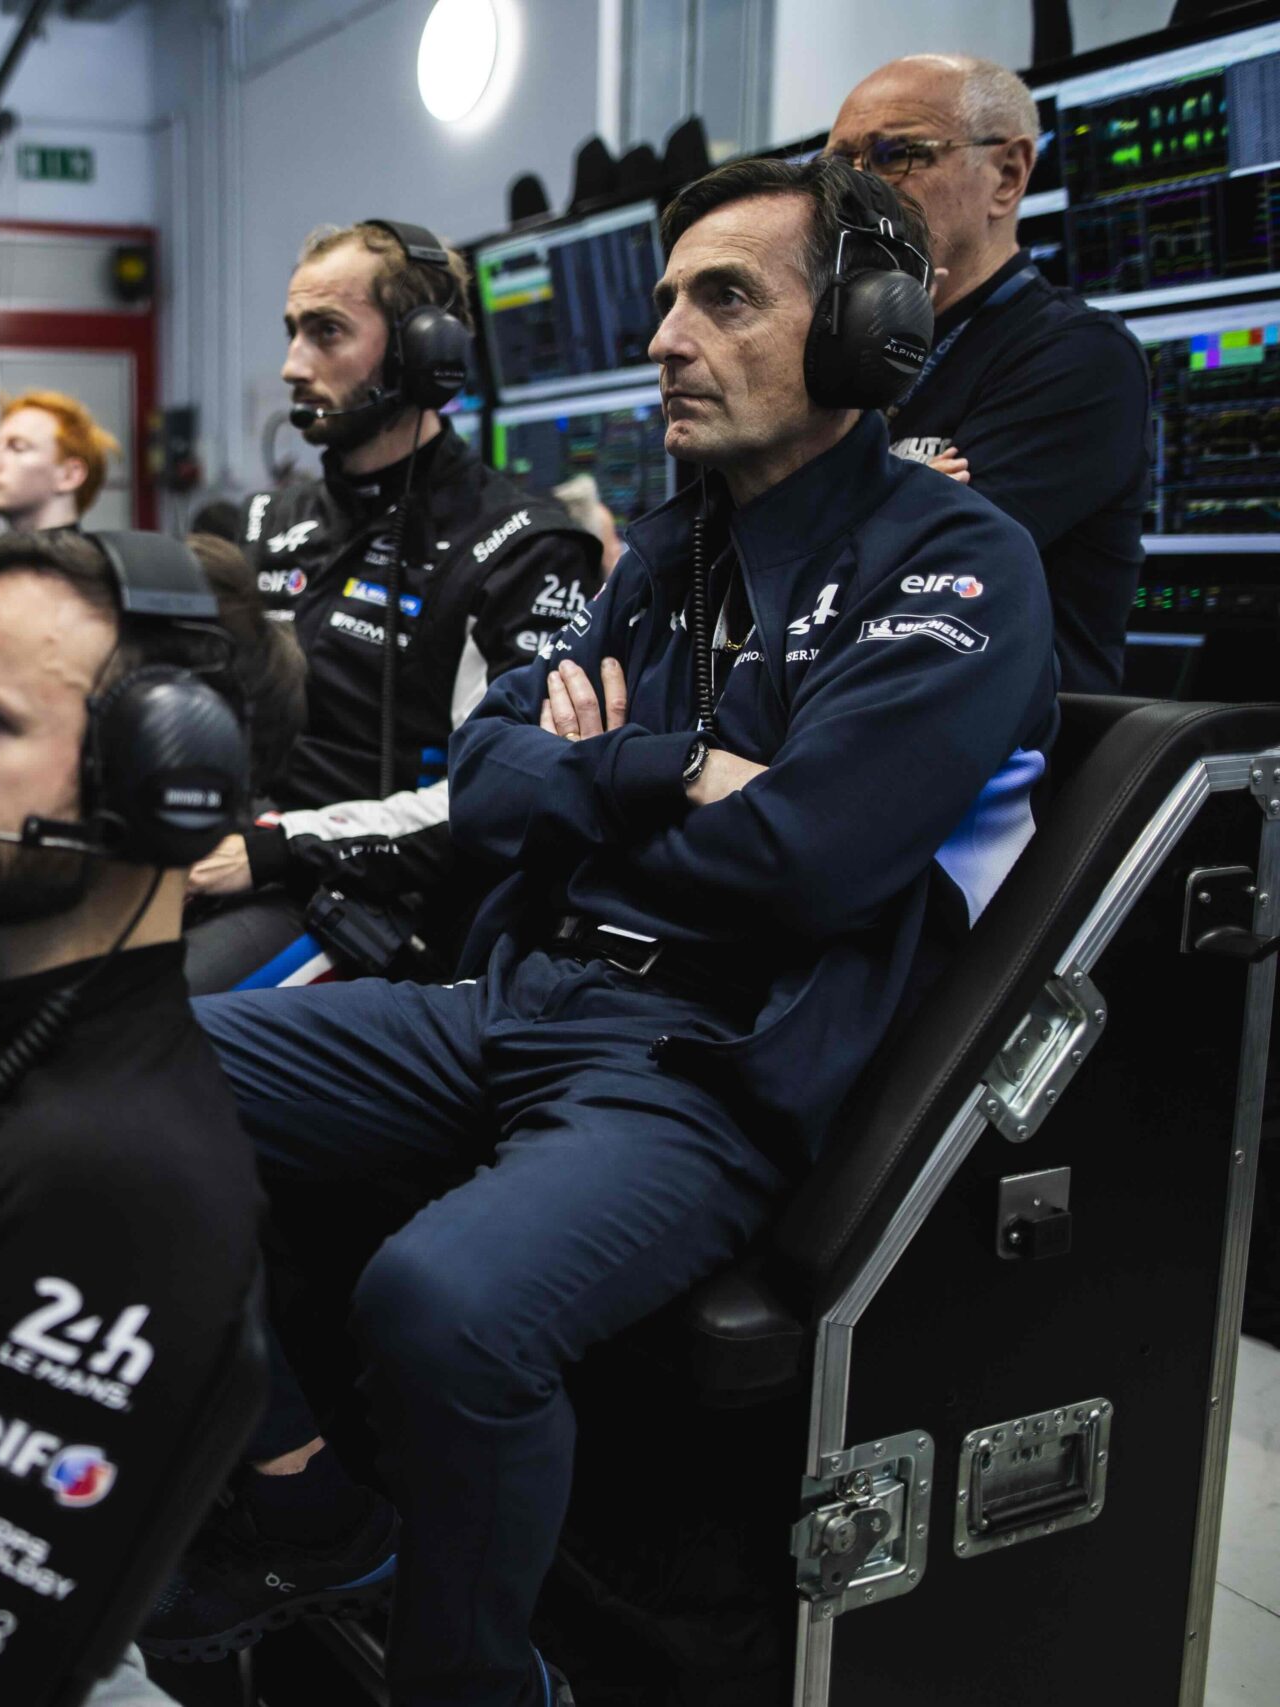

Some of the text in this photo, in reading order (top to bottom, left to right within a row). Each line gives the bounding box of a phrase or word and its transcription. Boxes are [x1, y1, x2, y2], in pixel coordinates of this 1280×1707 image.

[884, 343, 924, 362] ALPINE
[472, 508, 531, 563] Sabelt
[535, 573, 585, 612] 24h
[900, 575, 954, 594] elf
[895, 620, 975, 648] MICHELIN
[7, 1276, 154, 1385] 24h
[34, 1360, 133, 1411] MANS
